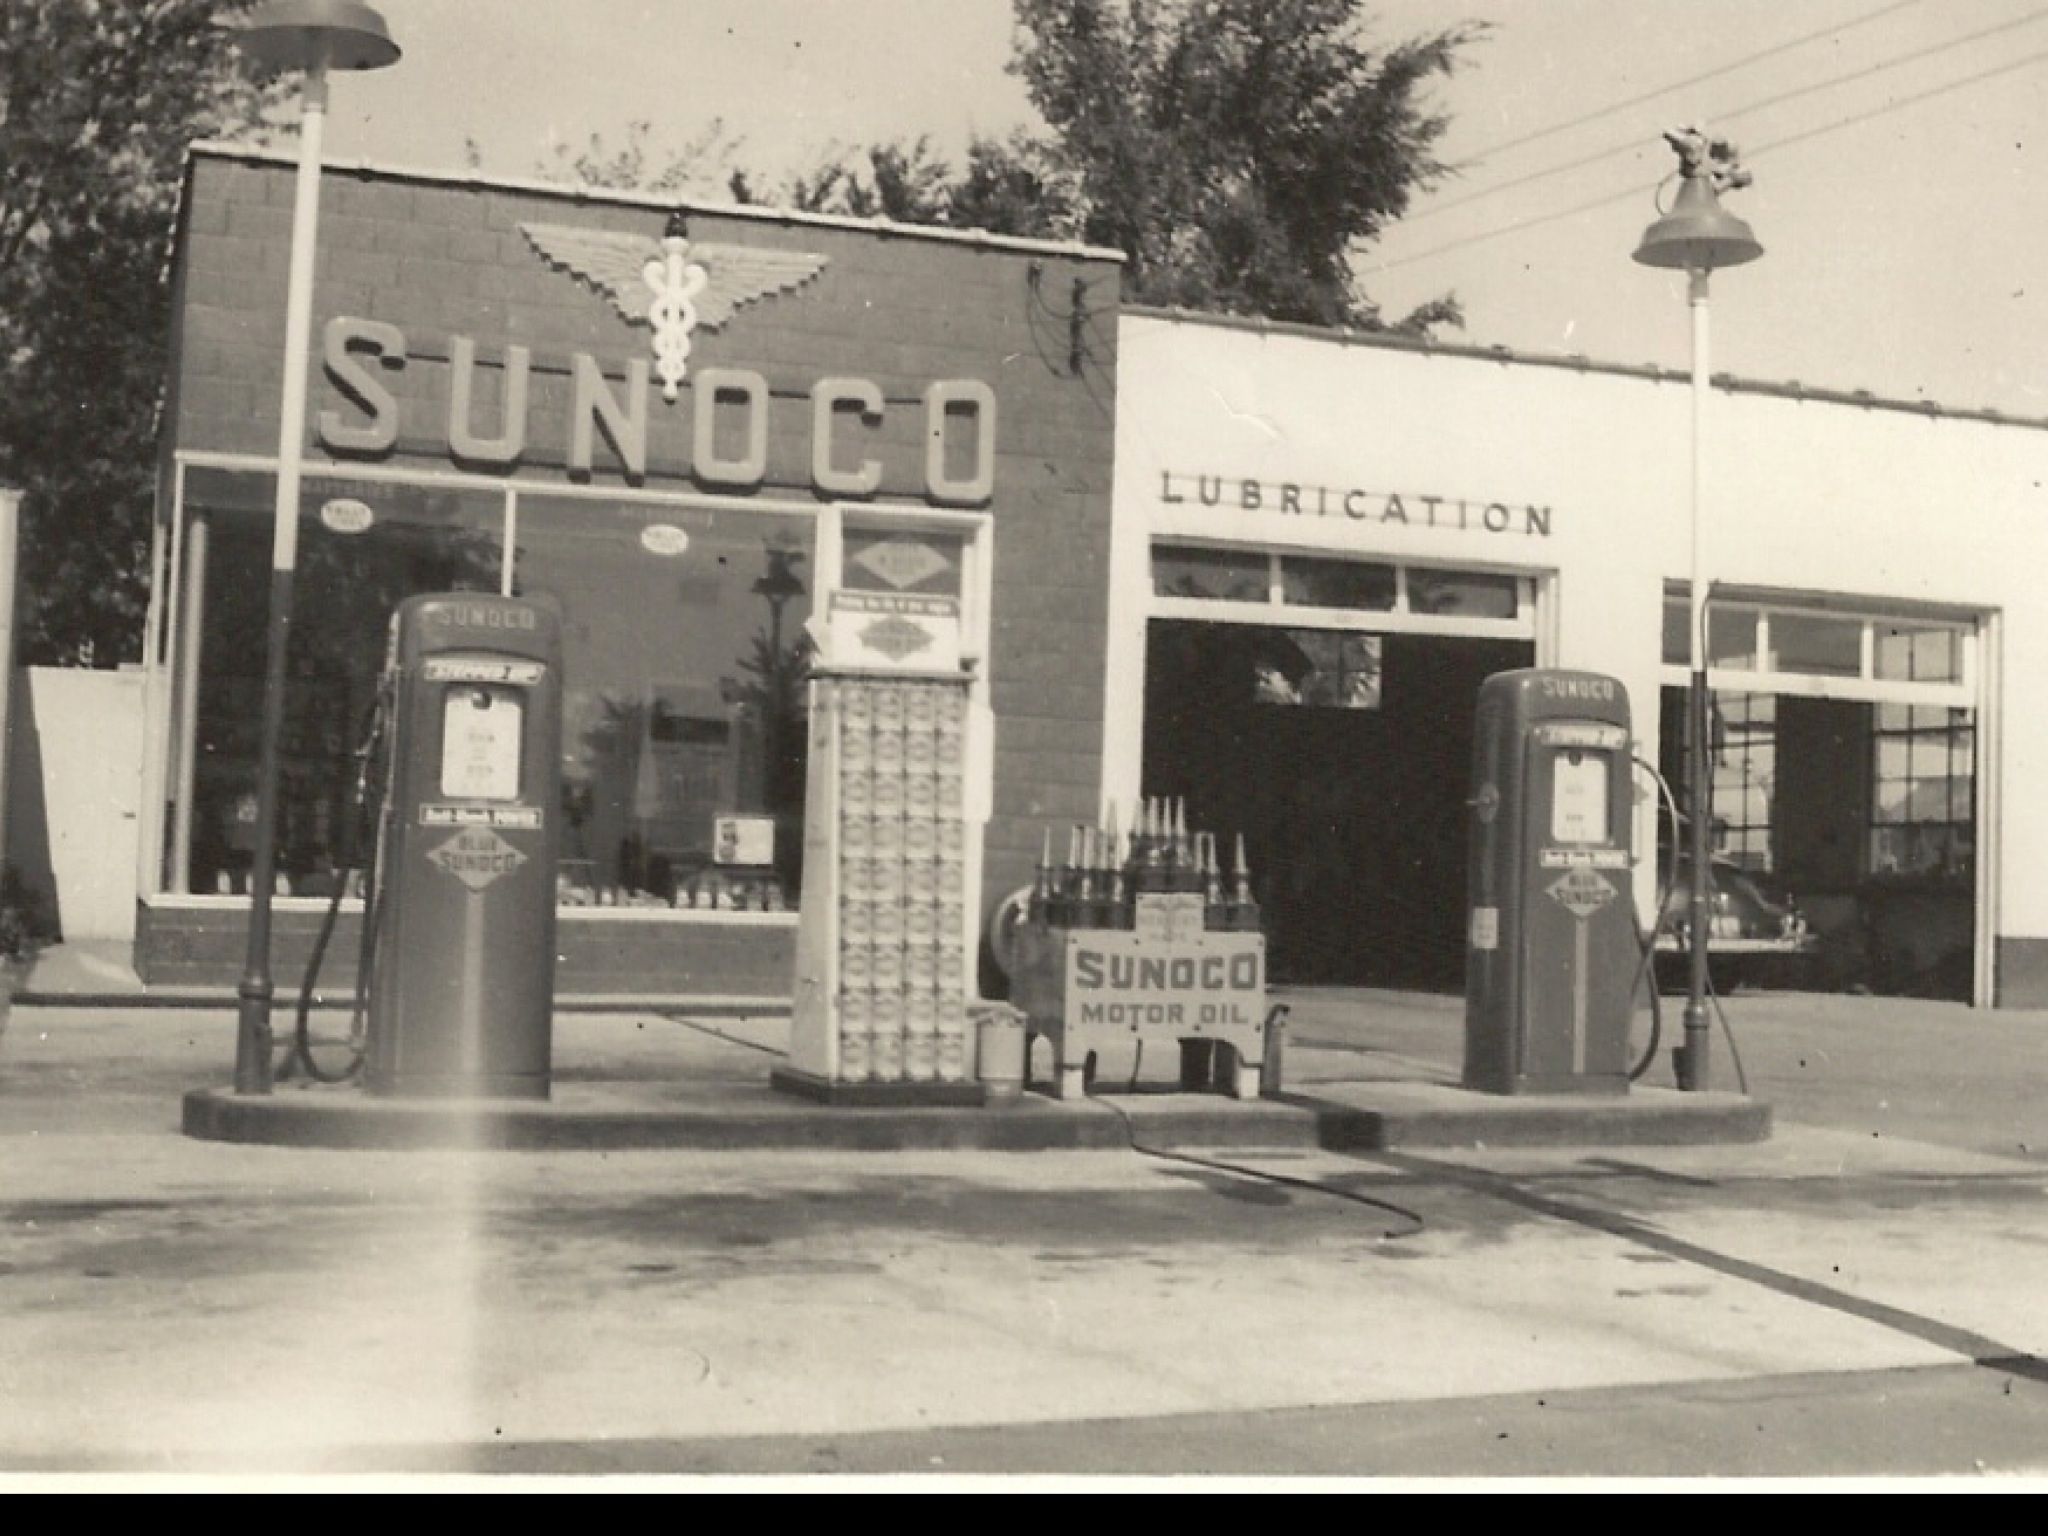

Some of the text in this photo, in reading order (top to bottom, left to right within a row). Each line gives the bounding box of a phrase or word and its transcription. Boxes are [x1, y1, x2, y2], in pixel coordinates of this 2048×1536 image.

[319, 316, 996, 503] SUNOCO
[1161, 470, 1553, 536] LUBRICATION
[439, 606, 536, 631] SUNOCO
[1542, 676, 1615, 700] SUNOCO
[458, 834, 498, 851] BLUE
[440, 850, 517, 873] SUNOCO
[1075, 949, 1258, 991] SUNOCO
[1080, 1002, 1249, 1025] MOTOR OIL
